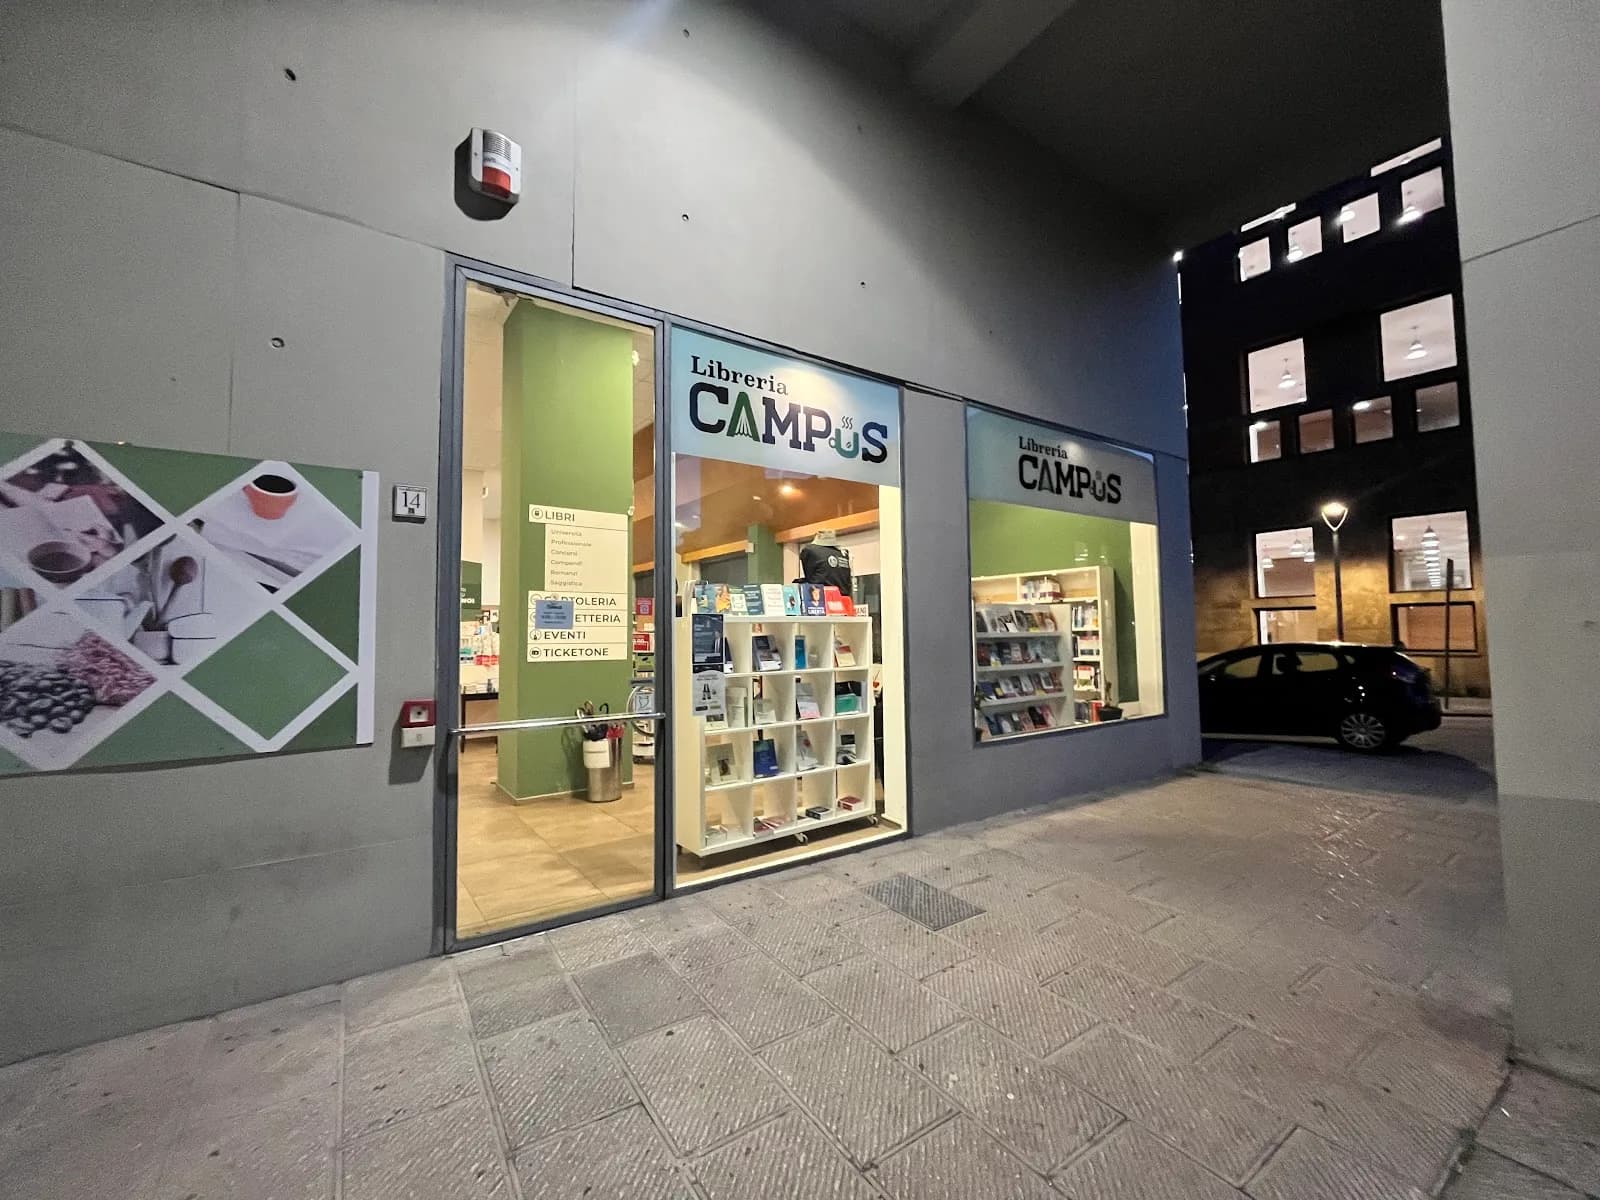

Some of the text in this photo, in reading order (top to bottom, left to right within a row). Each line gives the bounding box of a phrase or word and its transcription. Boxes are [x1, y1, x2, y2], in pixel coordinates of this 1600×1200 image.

[690, 355, 788, 396] Libreria
[689, 382, 888, 463] CAMPUS
[1019, 436, 1068, 459] Libreria
[1019, 454, 1121, 504] CAMPUS
[402, 491, 421, 509] 14
[545, 510, 575, 522] LIBRI
[544, 631, 586, 640] EVENTI
[544, 648, 609, 657] TICKETONE
